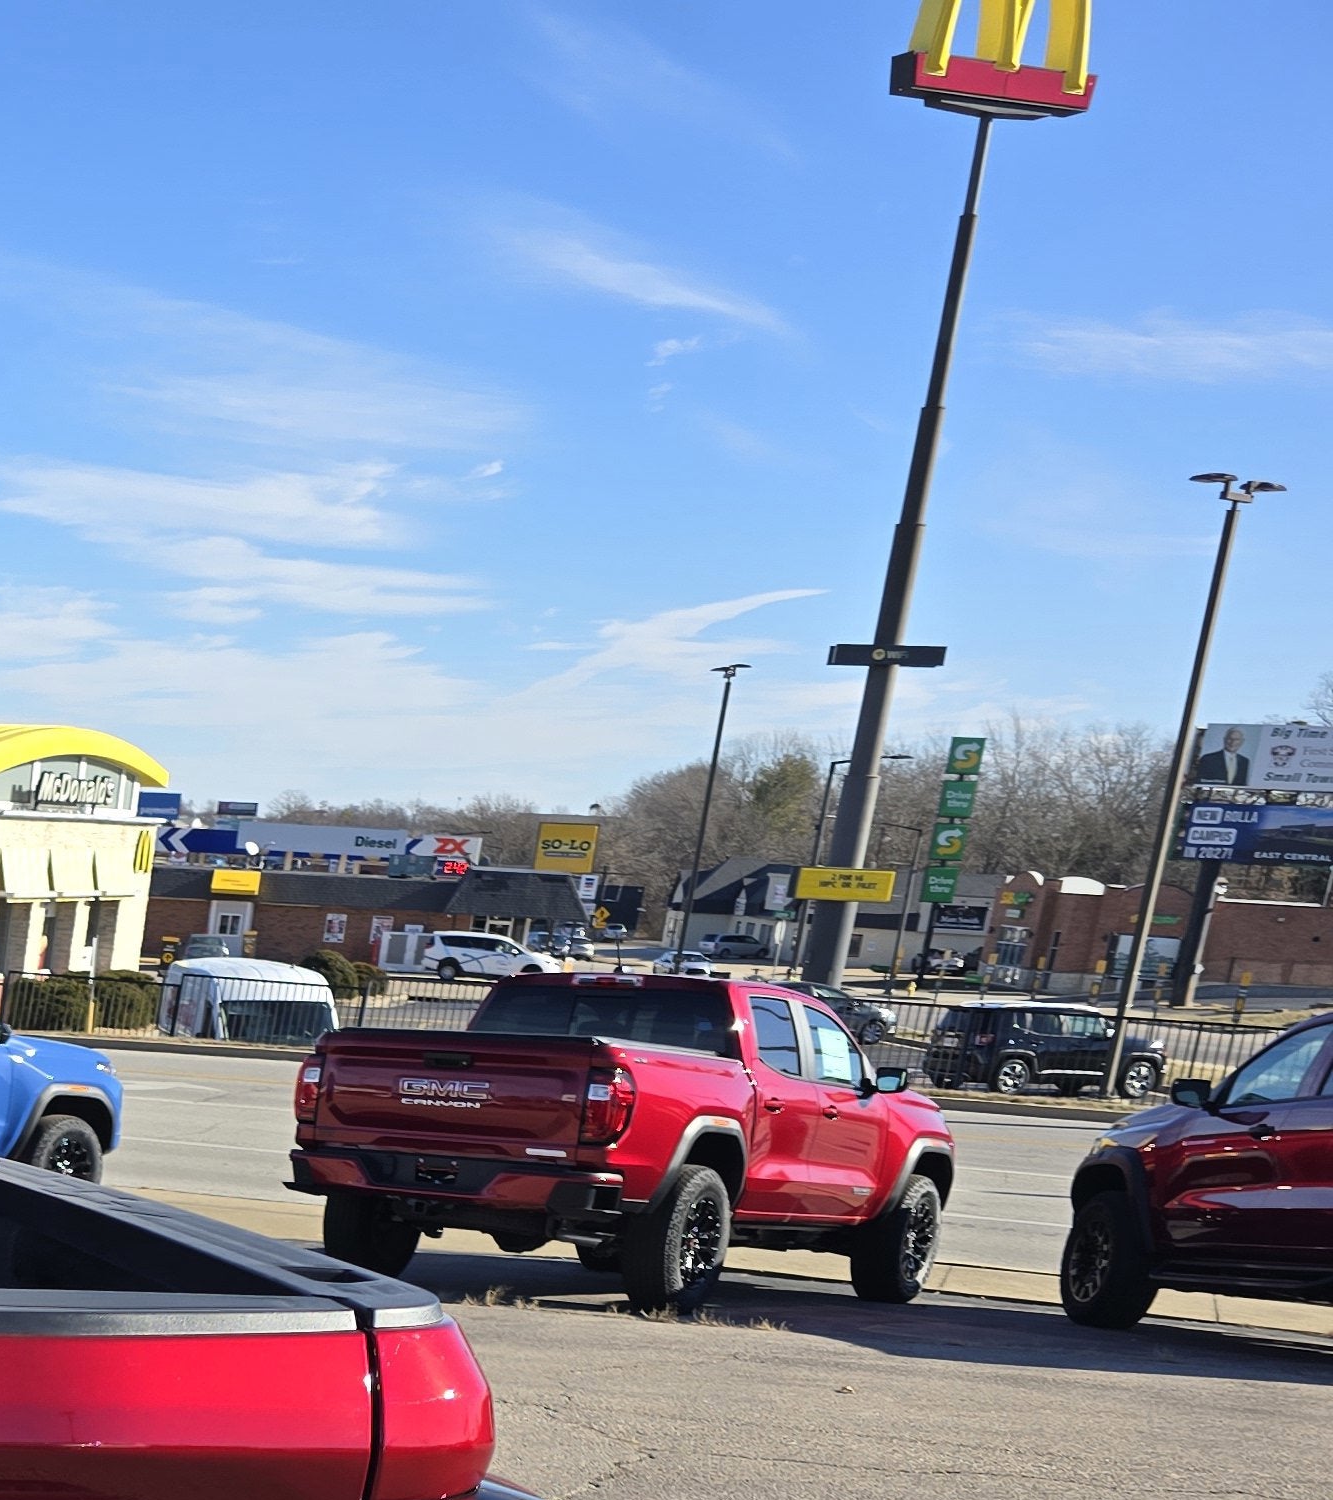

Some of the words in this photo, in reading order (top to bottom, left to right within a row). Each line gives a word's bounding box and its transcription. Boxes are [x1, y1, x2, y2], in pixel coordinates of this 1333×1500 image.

[1270, 727, 1293, 739] Big
[1297, 728, 1328, 739] Time
[1263, 772, 1302, 783] Small
[37, 771, 116, 806] McDonald's
[945, 790, 972, 800] Drive
[1191, 830, 1233, 842] CAMPUS
[355, 836, 397, 849] Diesel
[541, 839, 591, 851] SO-LO
[1253, 851, 1281, 860] EAST
[1284, 852, 1332, 863] CENTRAL
[929, 876, 955, 886] Drive
[399, 1077, 490, 1099] GMC
[401, 1097, 481, 1109] CANYON
